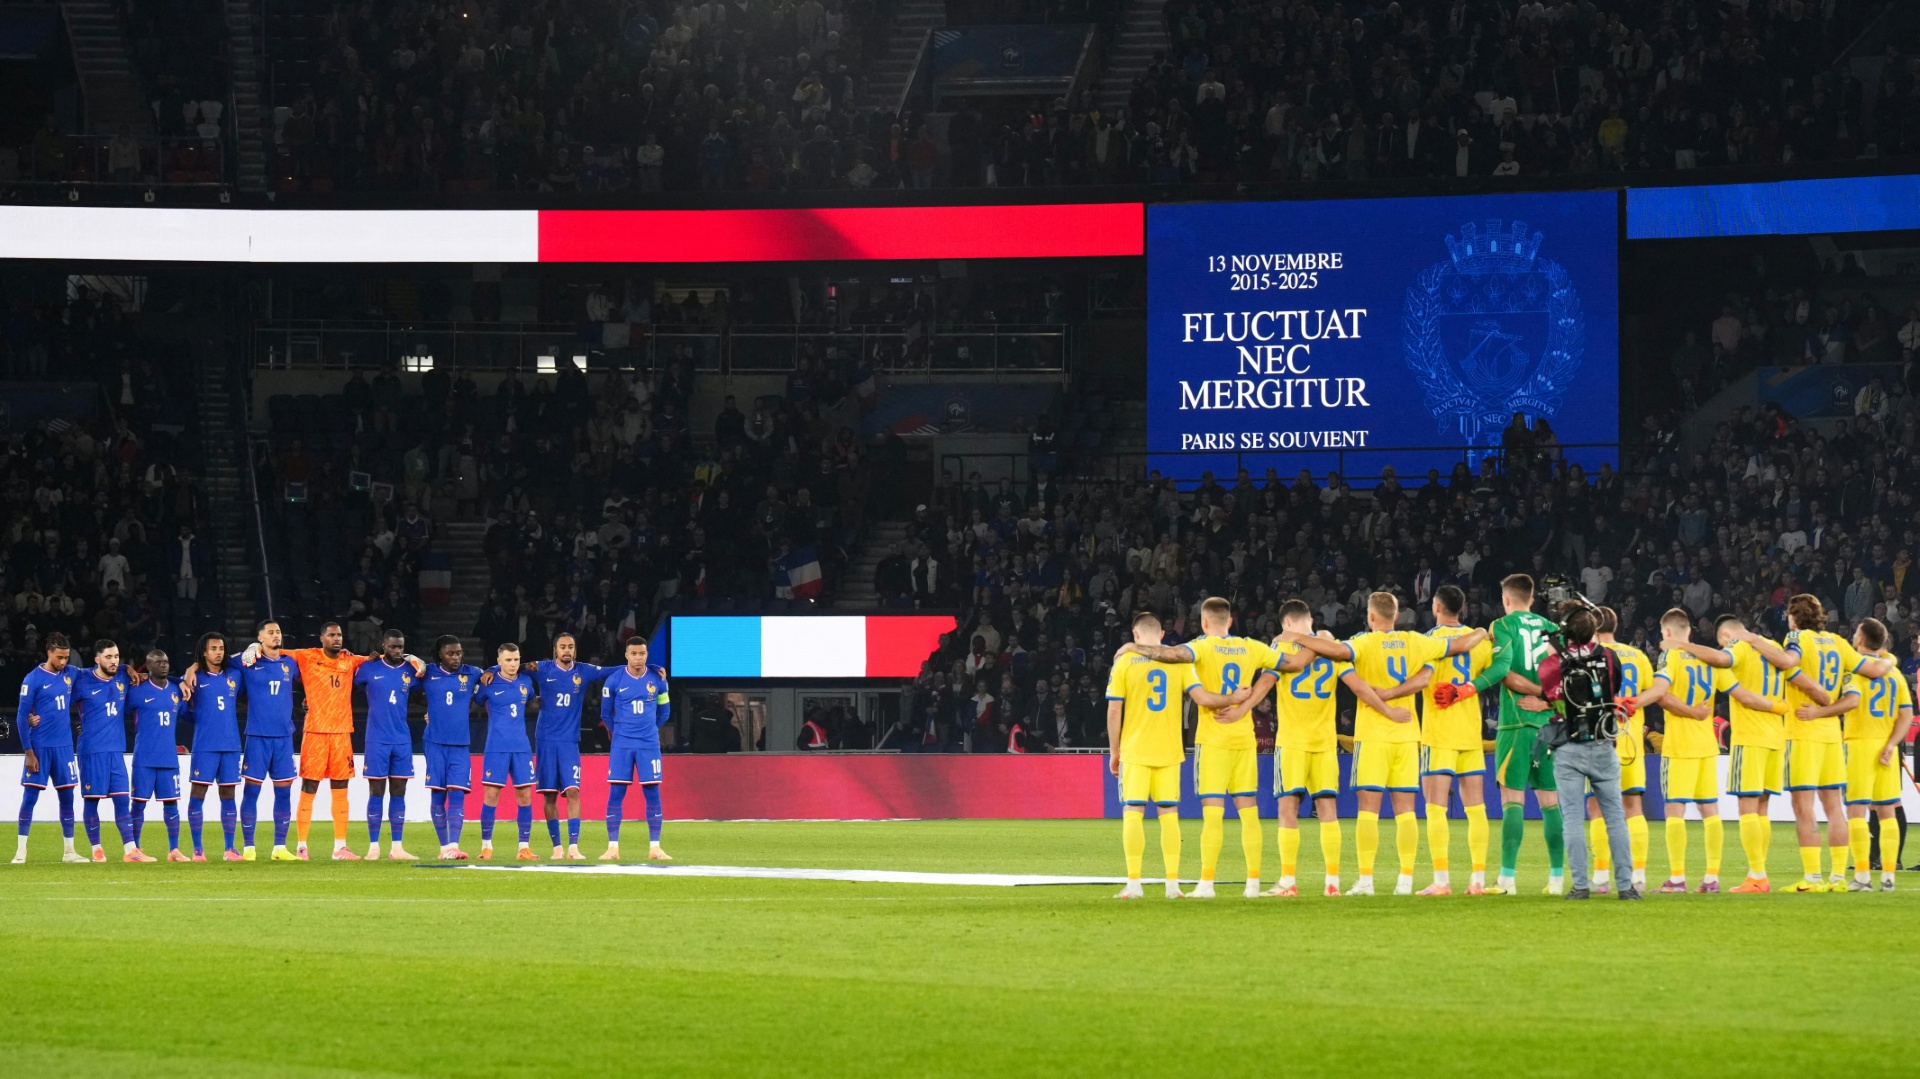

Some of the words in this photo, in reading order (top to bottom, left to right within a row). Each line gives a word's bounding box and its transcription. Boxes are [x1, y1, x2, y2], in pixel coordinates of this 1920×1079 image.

[1208, 255, 1226, 272] 13
[1231, 253, 1343, 272] NOVEMBRE
[1230, 272, 1318, 290] 2015-2025
[1182, 309, 1367, 342] FLUCTUAT
[1236, 344, 1310, 375] NEC
[1179, 377, 1370, 409] MERGITUR
[1432, 397, 1478, 417] FLVCTVAT
[1507, 397, 1555, 416] MERGITVR
[1483, 413, 1506, 425] NEC
[1181, 433, 1235, 450] PARIS
[1240, 432, 1264, 449] SE
[1268, 430, 1369, 448] SOUVIENT
[1220, 662, 1241, 695] 8
[1290, 656, 1334, 699] 22
[1387, 656, 1407, 685] 4
[1451, 652, 1470, 687] 9
[1817, 650, 1840, 692] 13
[268, 680, 281, 695] 17
[330, 675, 341, 688] 16
[1146, 669, 1167, 712] 3
[1685, 664, 1713, 706] 14
[54, 695, 65, 710] 11
[217, 696, 225, 710] 5
[389, 690, 397, 705] 4
[446, 691, 453, 706] 8
[556, 693, 571, 707] 20
[1869, 676, 1897, 718] 21
[105, 702, 118, 716] 14
[510, 703, 518, 718] 3
[631, 700, 644, 714] 10
[157, 711, 170, 726] 13
[529, 760, 535, 774] 3
[651, 759, 662, 774] 10
